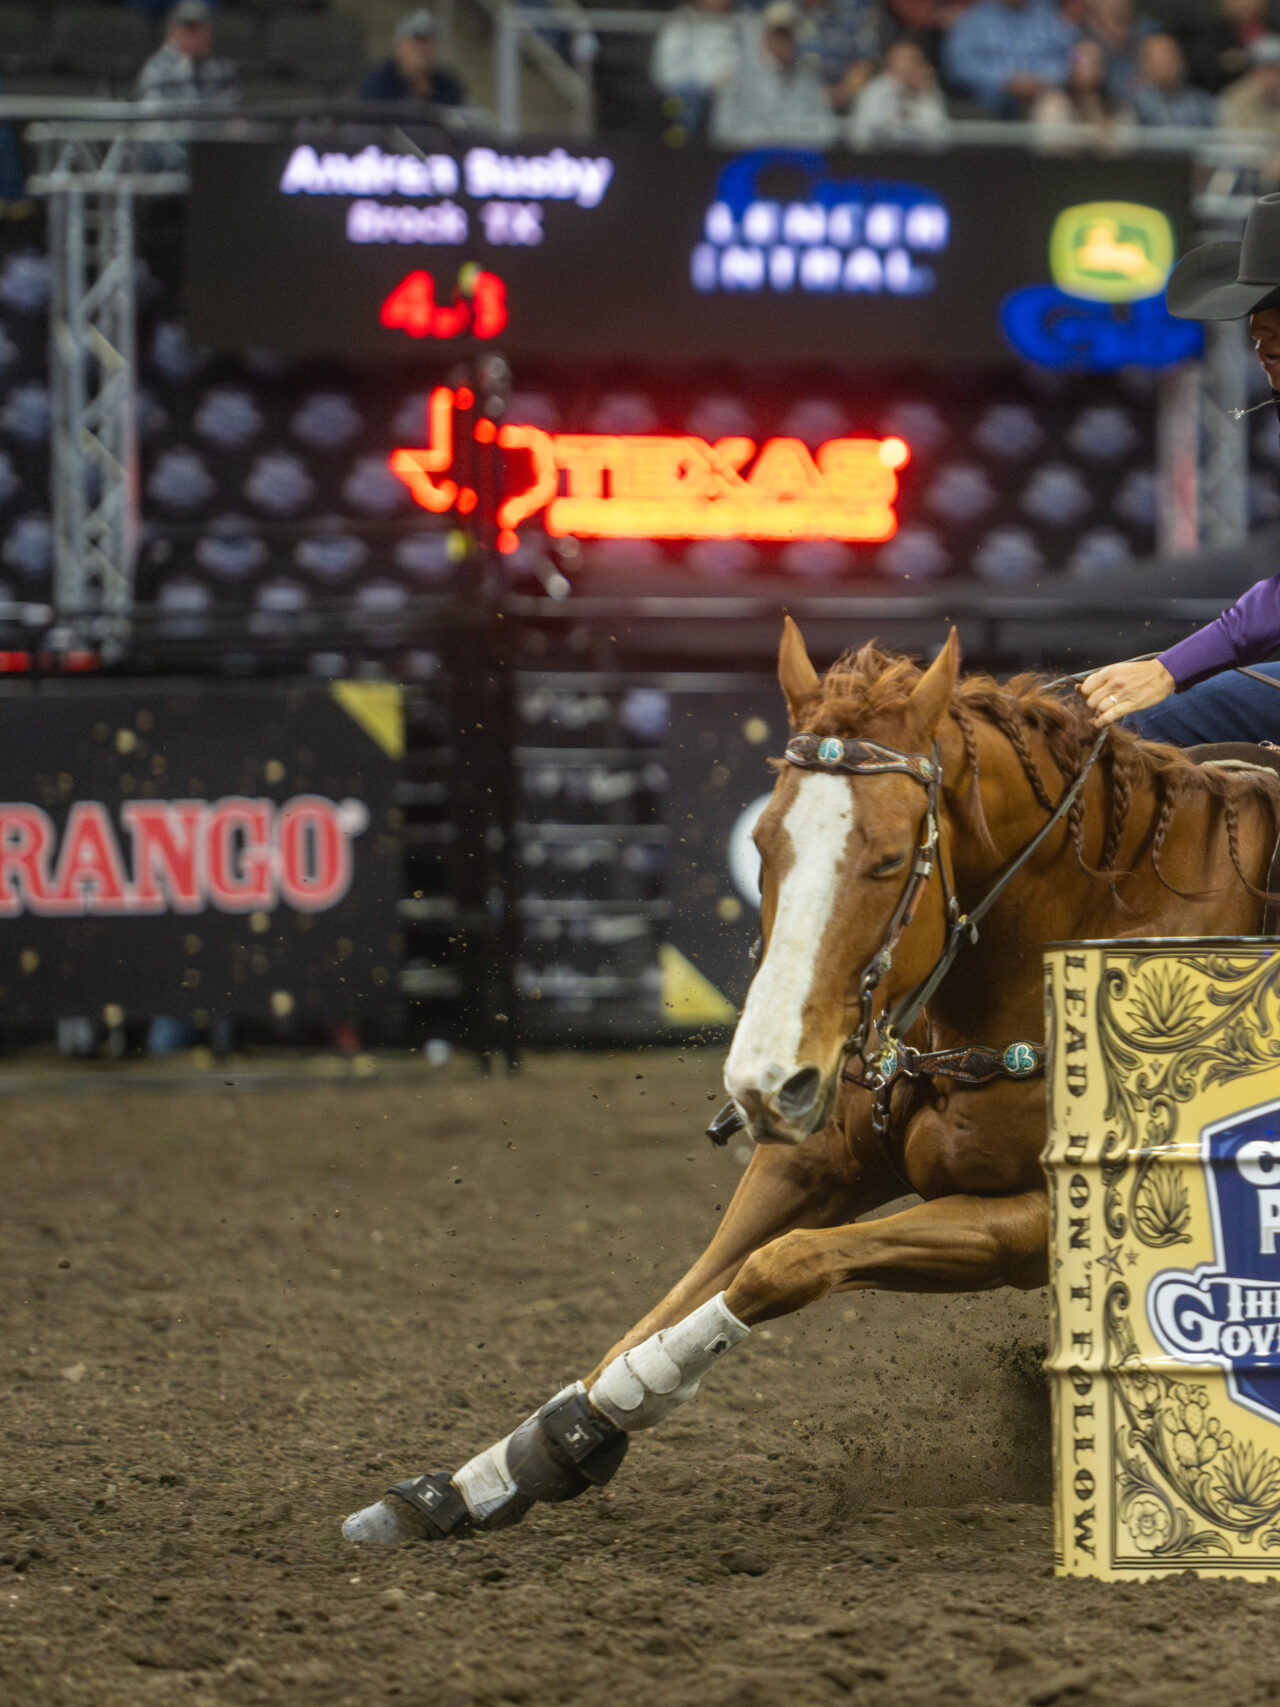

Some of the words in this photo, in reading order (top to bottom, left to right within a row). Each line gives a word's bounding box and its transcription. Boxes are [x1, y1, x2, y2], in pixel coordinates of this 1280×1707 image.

[280, 145, 459, 196] Andrea
[464, 147, 614, 208] Busby
[550, 434, 902, 506] TEXAS
